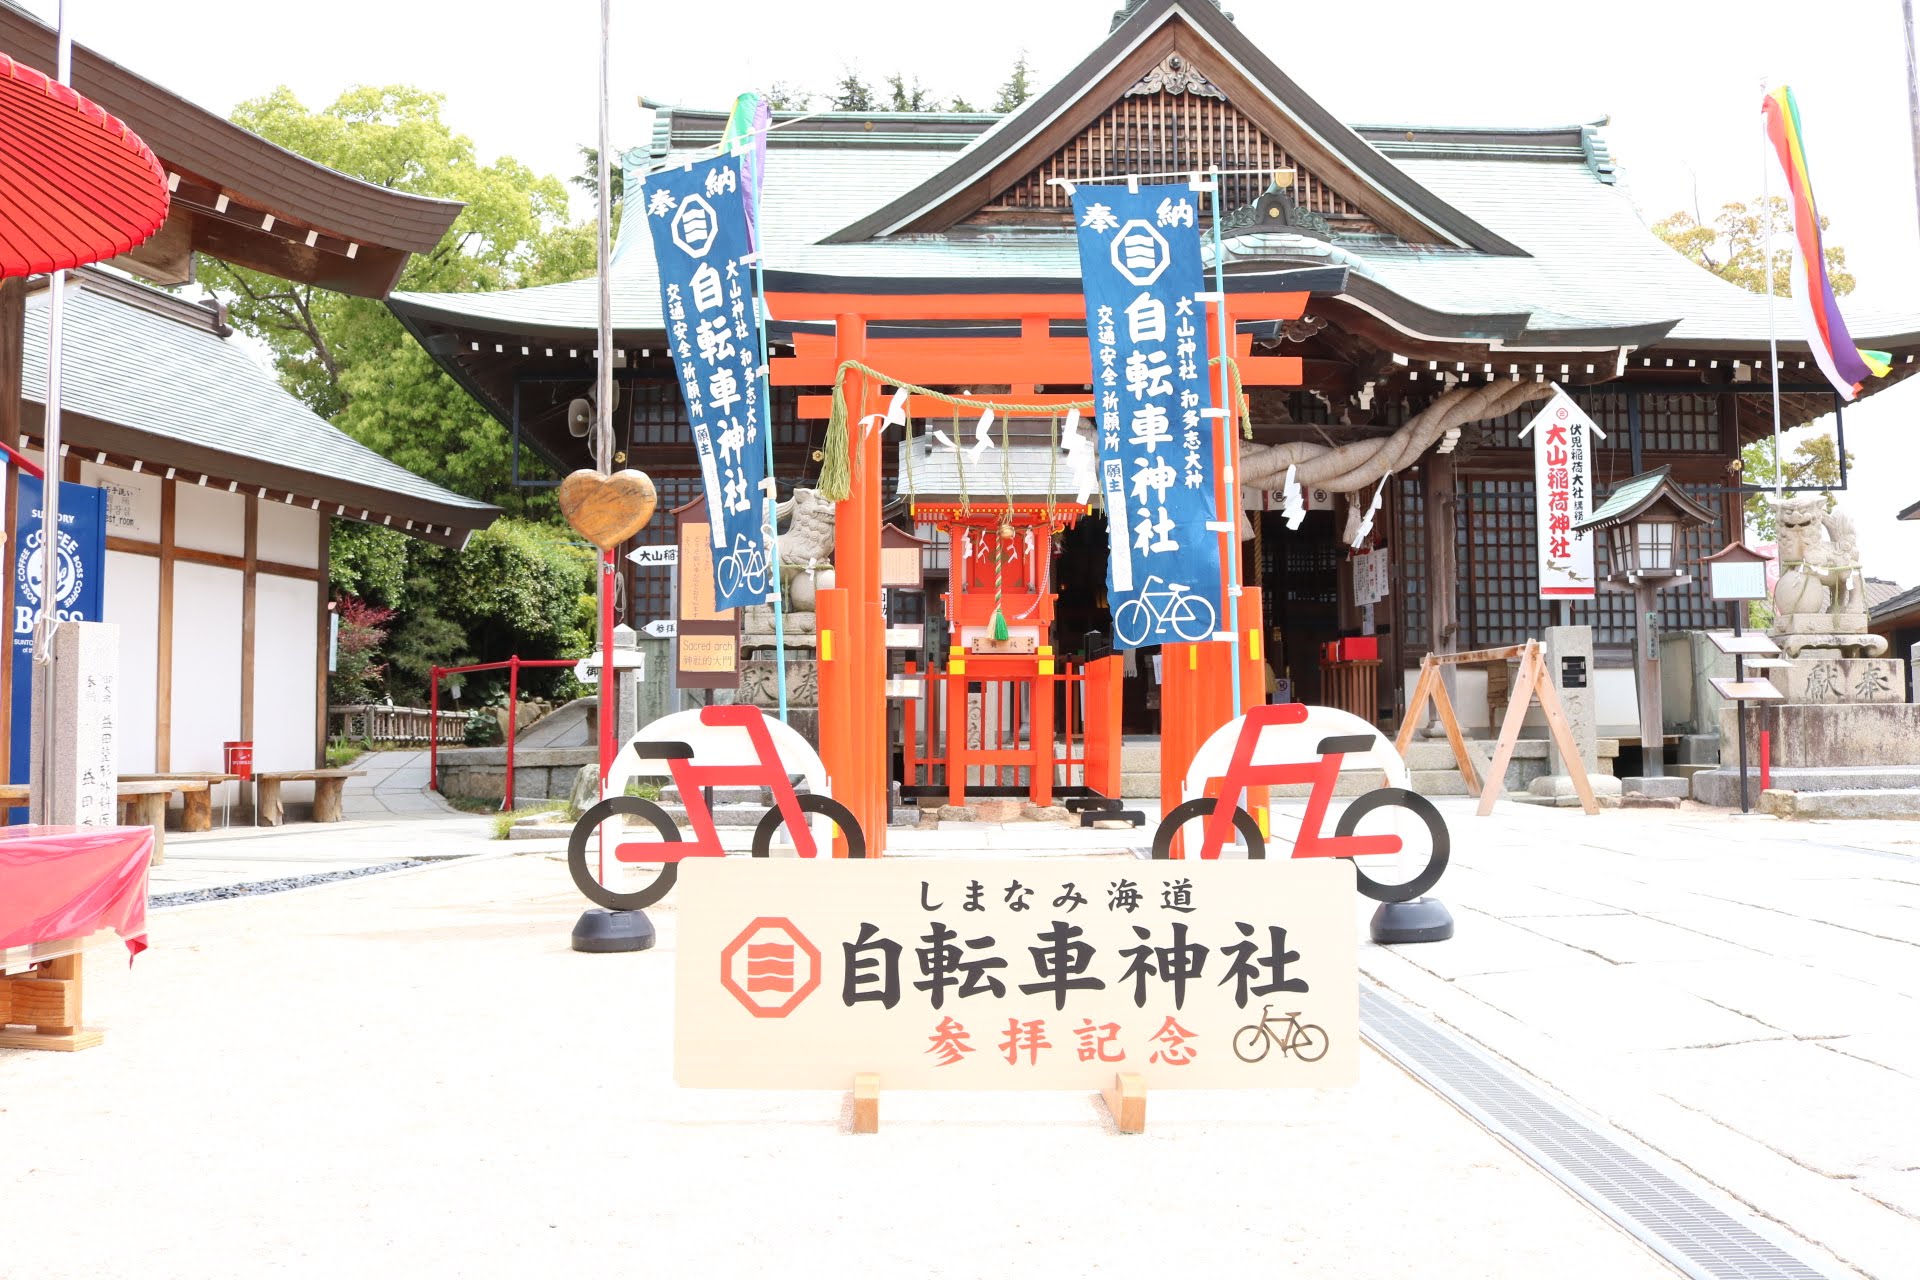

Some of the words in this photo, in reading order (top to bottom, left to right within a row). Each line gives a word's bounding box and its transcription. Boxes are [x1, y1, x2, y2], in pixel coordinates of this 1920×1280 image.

[666, 282, 692, 360] 交通安全
[682, 361, 703, 420] 祈願所
[725, 258, 749, 341] 大山神社
[739, 347, 757, 444] 和多志大神
[1096, 304, 1119, 388] 交通安全
[1175, 295, 1198, 381] 大山神社
[689, 262, 751, 518] 自転車神社
[1101, 390, 1122, 454] 祈願所
[1123, 291, 1180, 558] 自転車神社
[697, 428, 710, 456] 願主
[1105, 463, 1123, 493] 願主
[1180, 388, 1204, 490] 和多志大神
[1570, 424, 1584, 499] 伏見稲荷大社
[31, 509, 75, 524] SUORY
[1545, 423, 1572, 559] 大山稲荷神社
[640, 550, 678, 562] 大山稲
[683, 640, 710, 651] Sacred
[714, 641, 733, 651] arch
[920, 877, 1198, 914] しまなみ海道
[840, 920, 1311, 1012] 自転車神社
[925, 1016, 1201, 1067] 参拝記念
